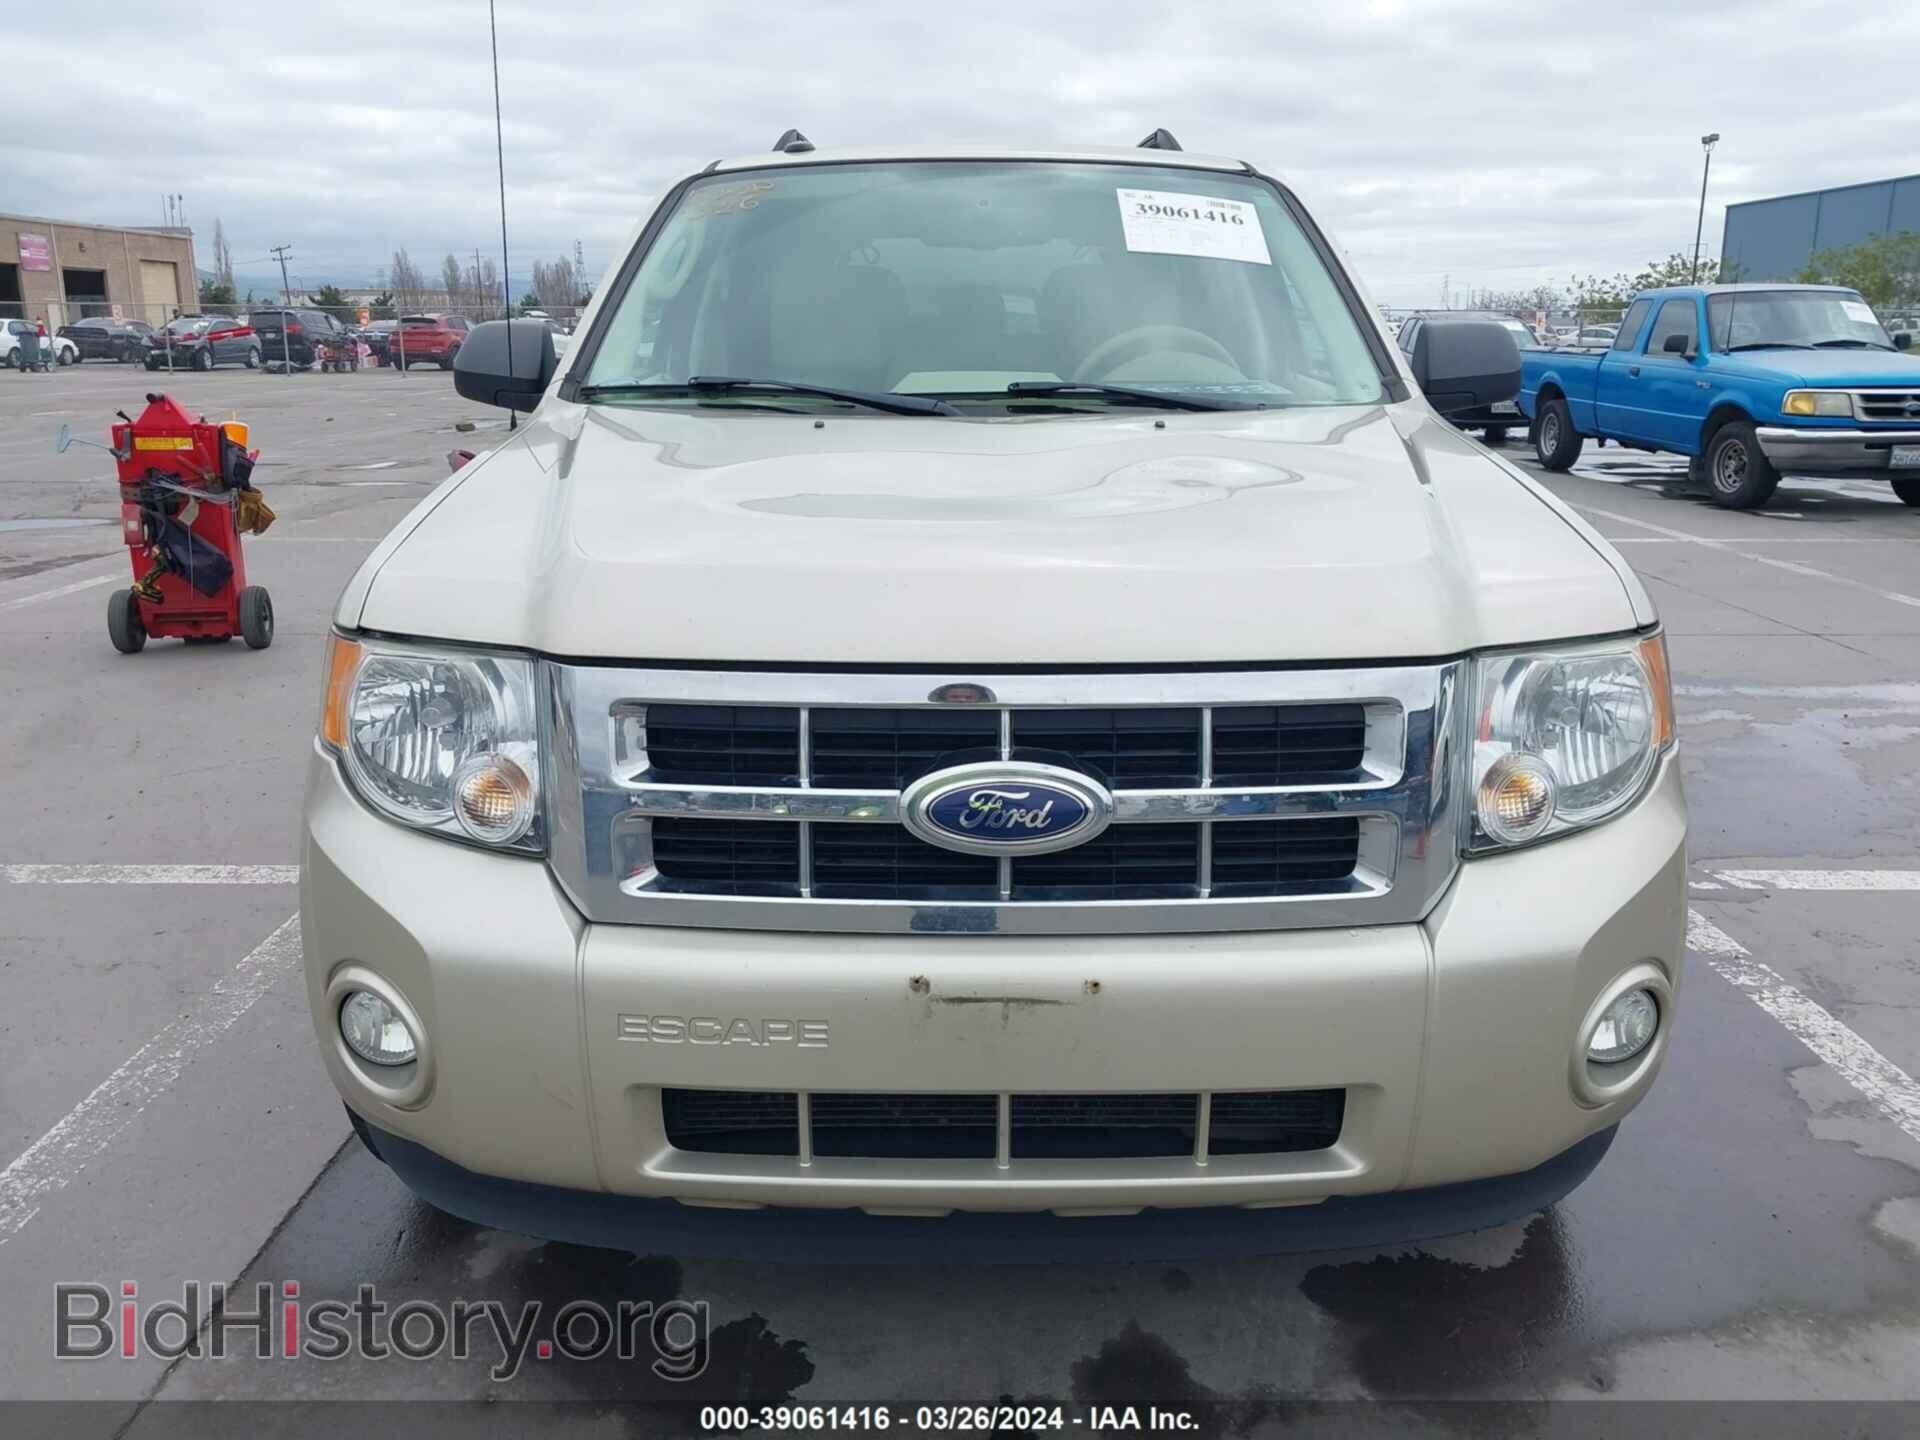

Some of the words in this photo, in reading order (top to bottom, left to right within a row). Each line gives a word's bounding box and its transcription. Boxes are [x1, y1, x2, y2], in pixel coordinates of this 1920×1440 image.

[1135, 202, 1244, 226] 39061416
[959, 789, 1054, 829] Ford
[616, 1012, 830, 1048] ESCAPE
